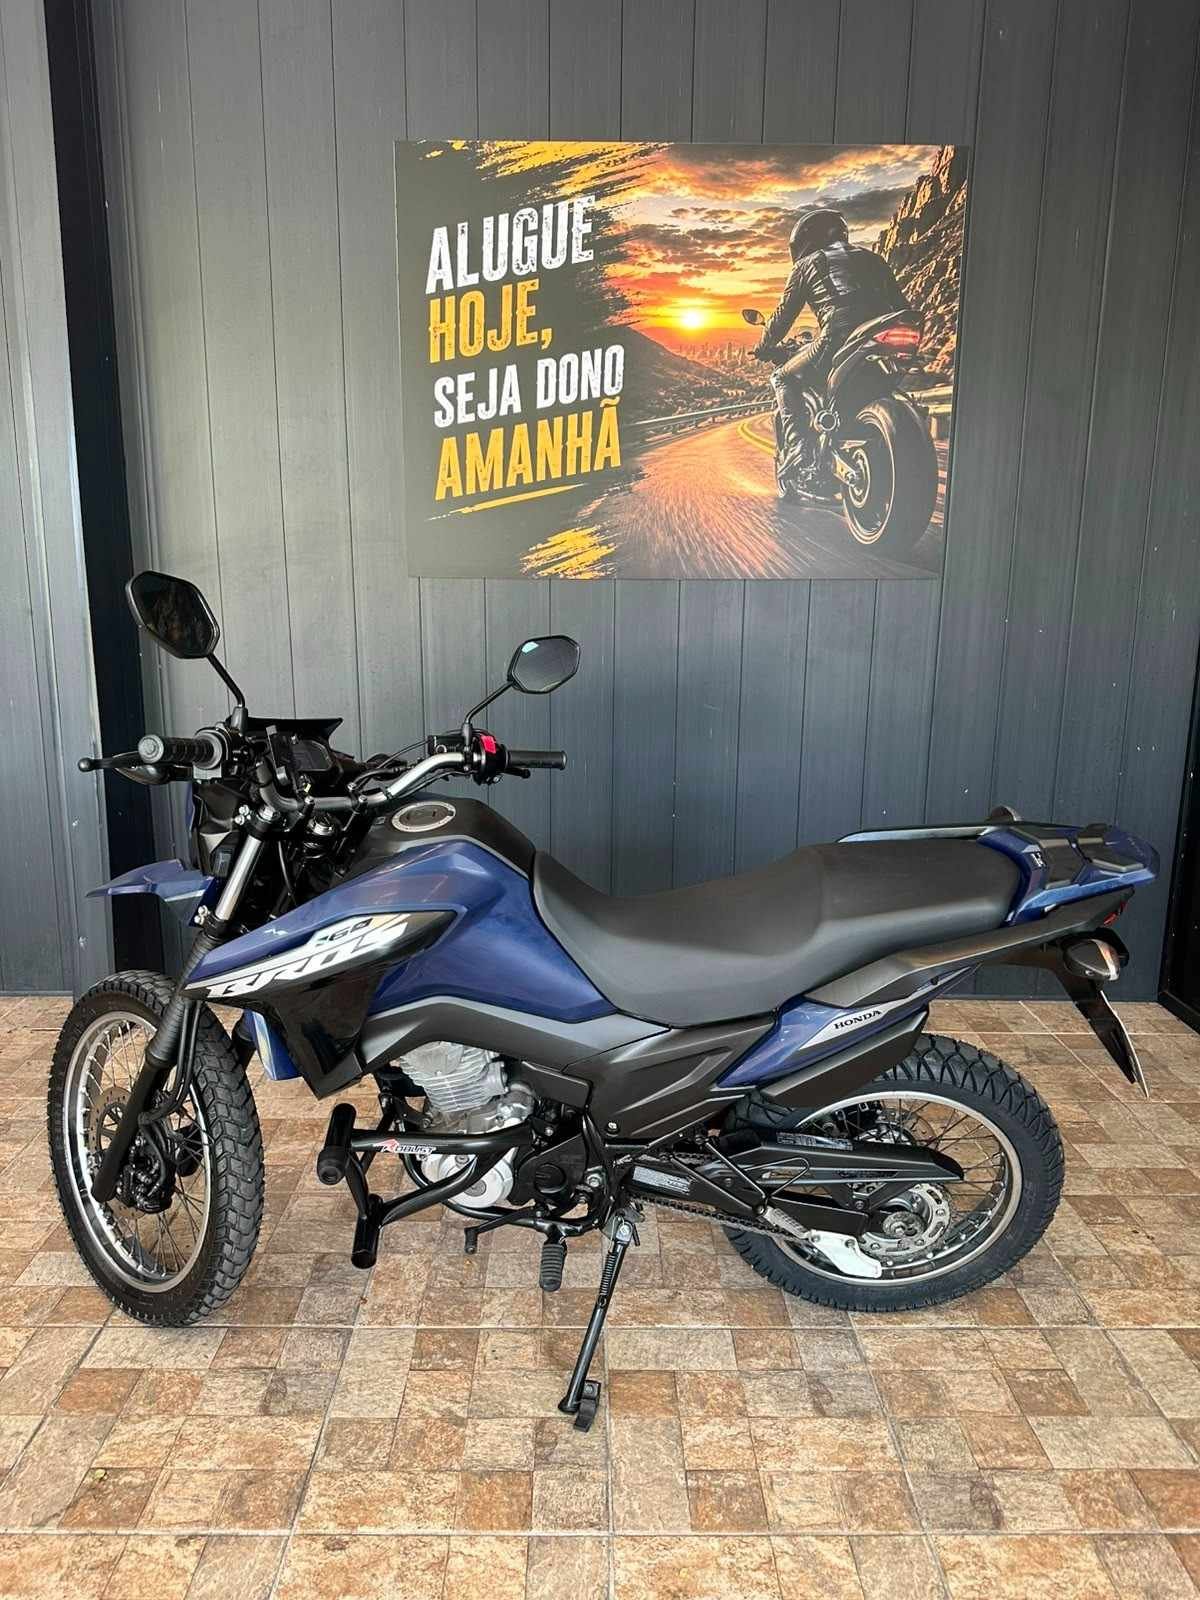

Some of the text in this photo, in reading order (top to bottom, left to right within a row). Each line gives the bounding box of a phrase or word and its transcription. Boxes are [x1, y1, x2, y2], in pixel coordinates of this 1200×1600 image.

[425, 195, 596, 294] ALUGUE
[429, 279, 553, 363] HOJE,
[434, 344, 625, 428] SEJA DONO
[435, 396, 621, 500] AMANHÃ
[206, 913, 412, 998] BROS
[833, 1010, 882, 1029] HONDA
